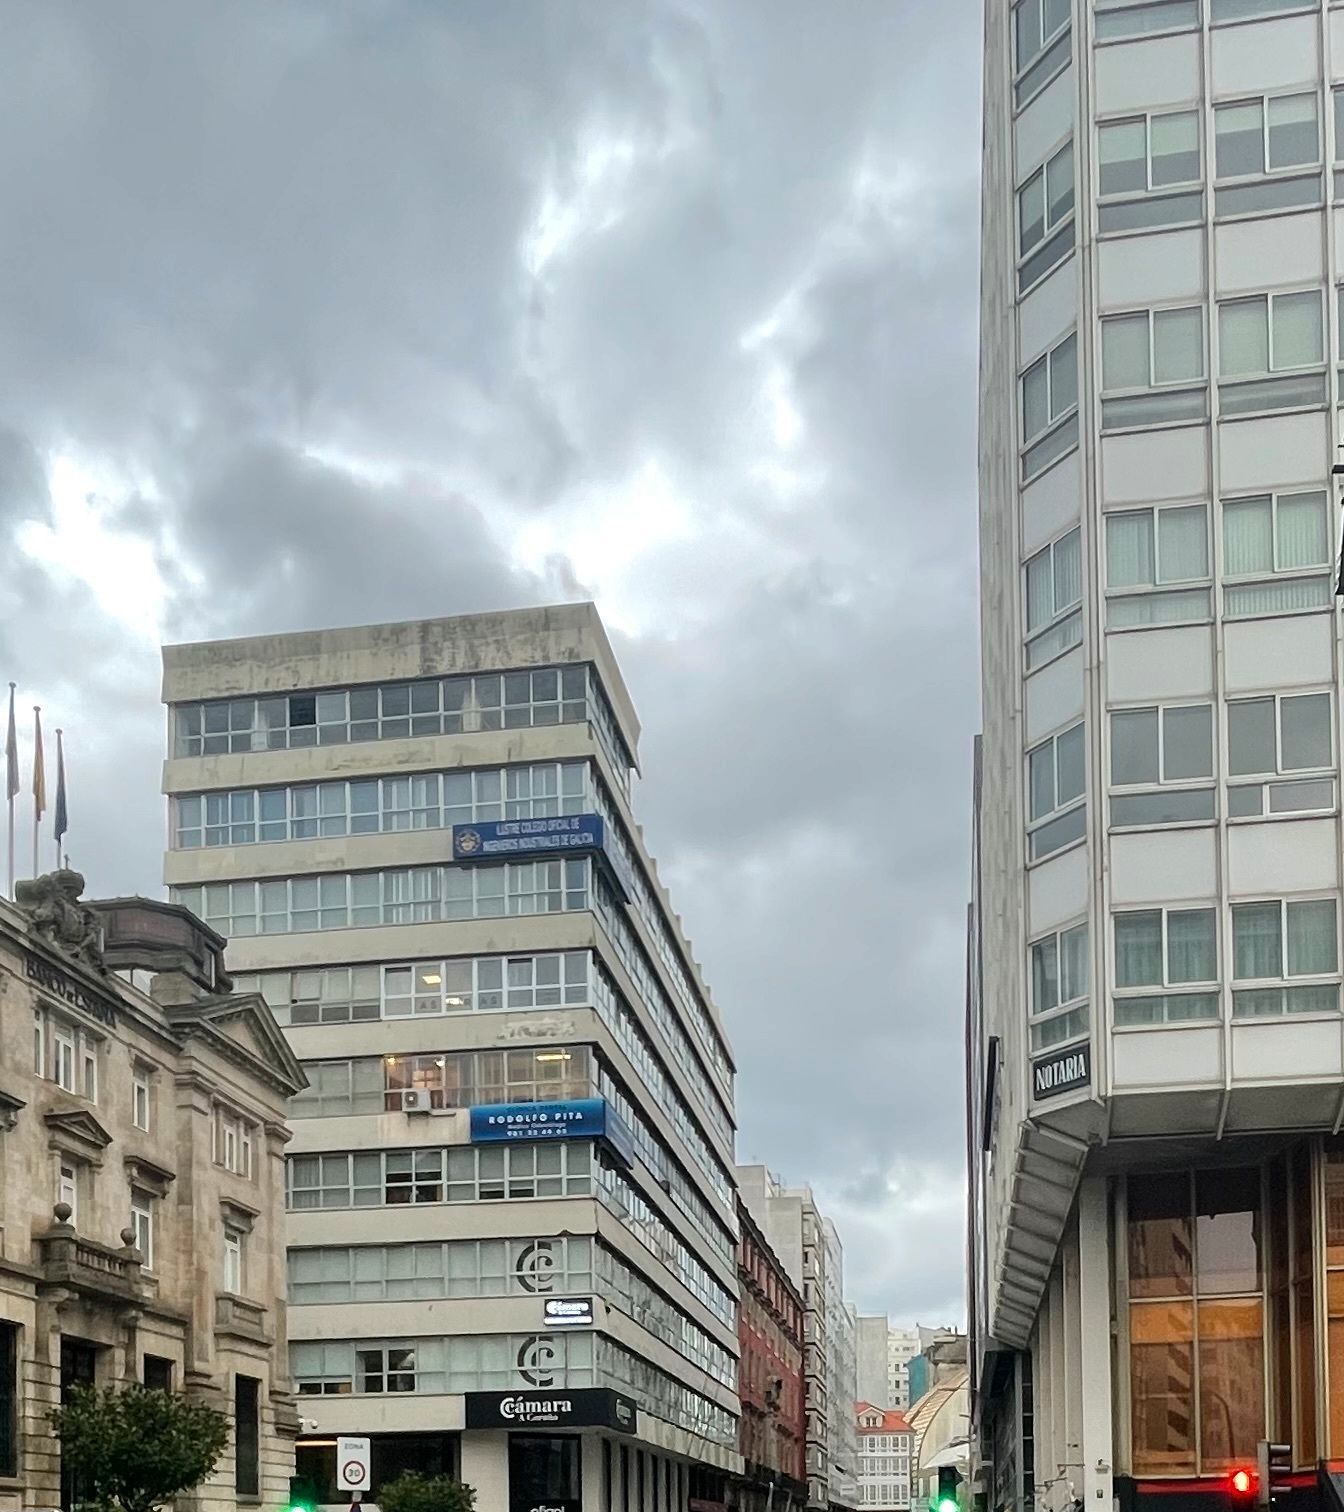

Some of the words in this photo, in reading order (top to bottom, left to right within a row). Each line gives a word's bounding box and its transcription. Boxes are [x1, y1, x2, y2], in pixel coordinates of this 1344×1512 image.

[1036, 1054, 1086, 1091] NOTARIA
[488, 1113, 547, 1124] RODOLFO
[554, 1112, 583, 1121] PITA
[348, 1468, 361, 1478] 30
